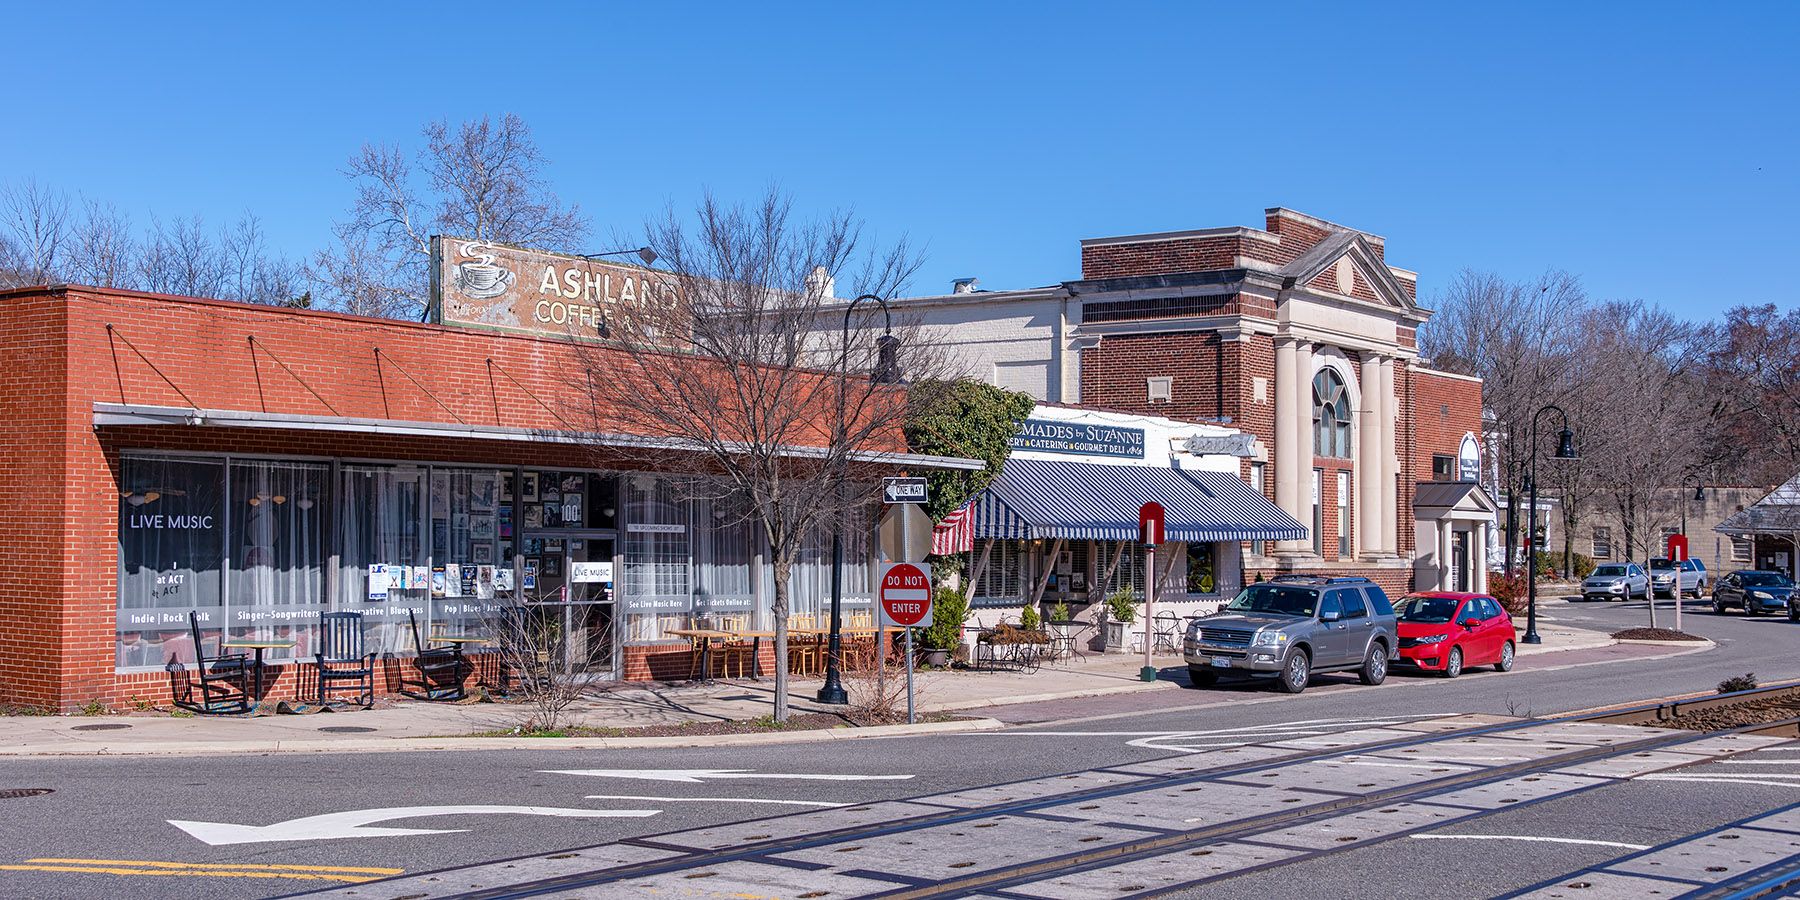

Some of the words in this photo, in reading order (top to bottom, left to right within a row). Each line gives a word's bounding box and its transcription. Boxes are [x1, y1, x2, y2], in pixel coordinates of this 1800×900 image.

[539, 265, 678, 311] ASHLAND
[536, 300, 614, 330] COFFEE
[1013, 422, 1073, 439] EMADES
[1076, 428, 1084, 439] by
[1086, 426, 1142, 445] SUZANNE
[1030, 440, 1068, 450] CATERING
[1074, 442, 1107, 453] GOURMET
[1110, 445, 1124, 454] DELI
[896, 485, 908, 495] ONE
[910, 485, 922, 495] WAY
[561, 504, 578, 522] 100
[130, 515, 164, 529] LIVE
[168, 515, 213, 529] MUSIC
[574, 568, 588, 577] LIVE
[590, 568, 610, 577] MUSIC
[157, 576, 166, 584] at
[168, 575, 184, 584] ACT
[888, 576, 900, 586] DO
[904, 576, 923, 586] NOT
[444, 605, 458, 614] Pop
[640, 600, 652, 608] Live
[653, 600, 669, 608] Music
[892, 603, 921, 614] ENTER
[131, 614, 155, 624] Indie
[163, 613, 184, 623] Rock
